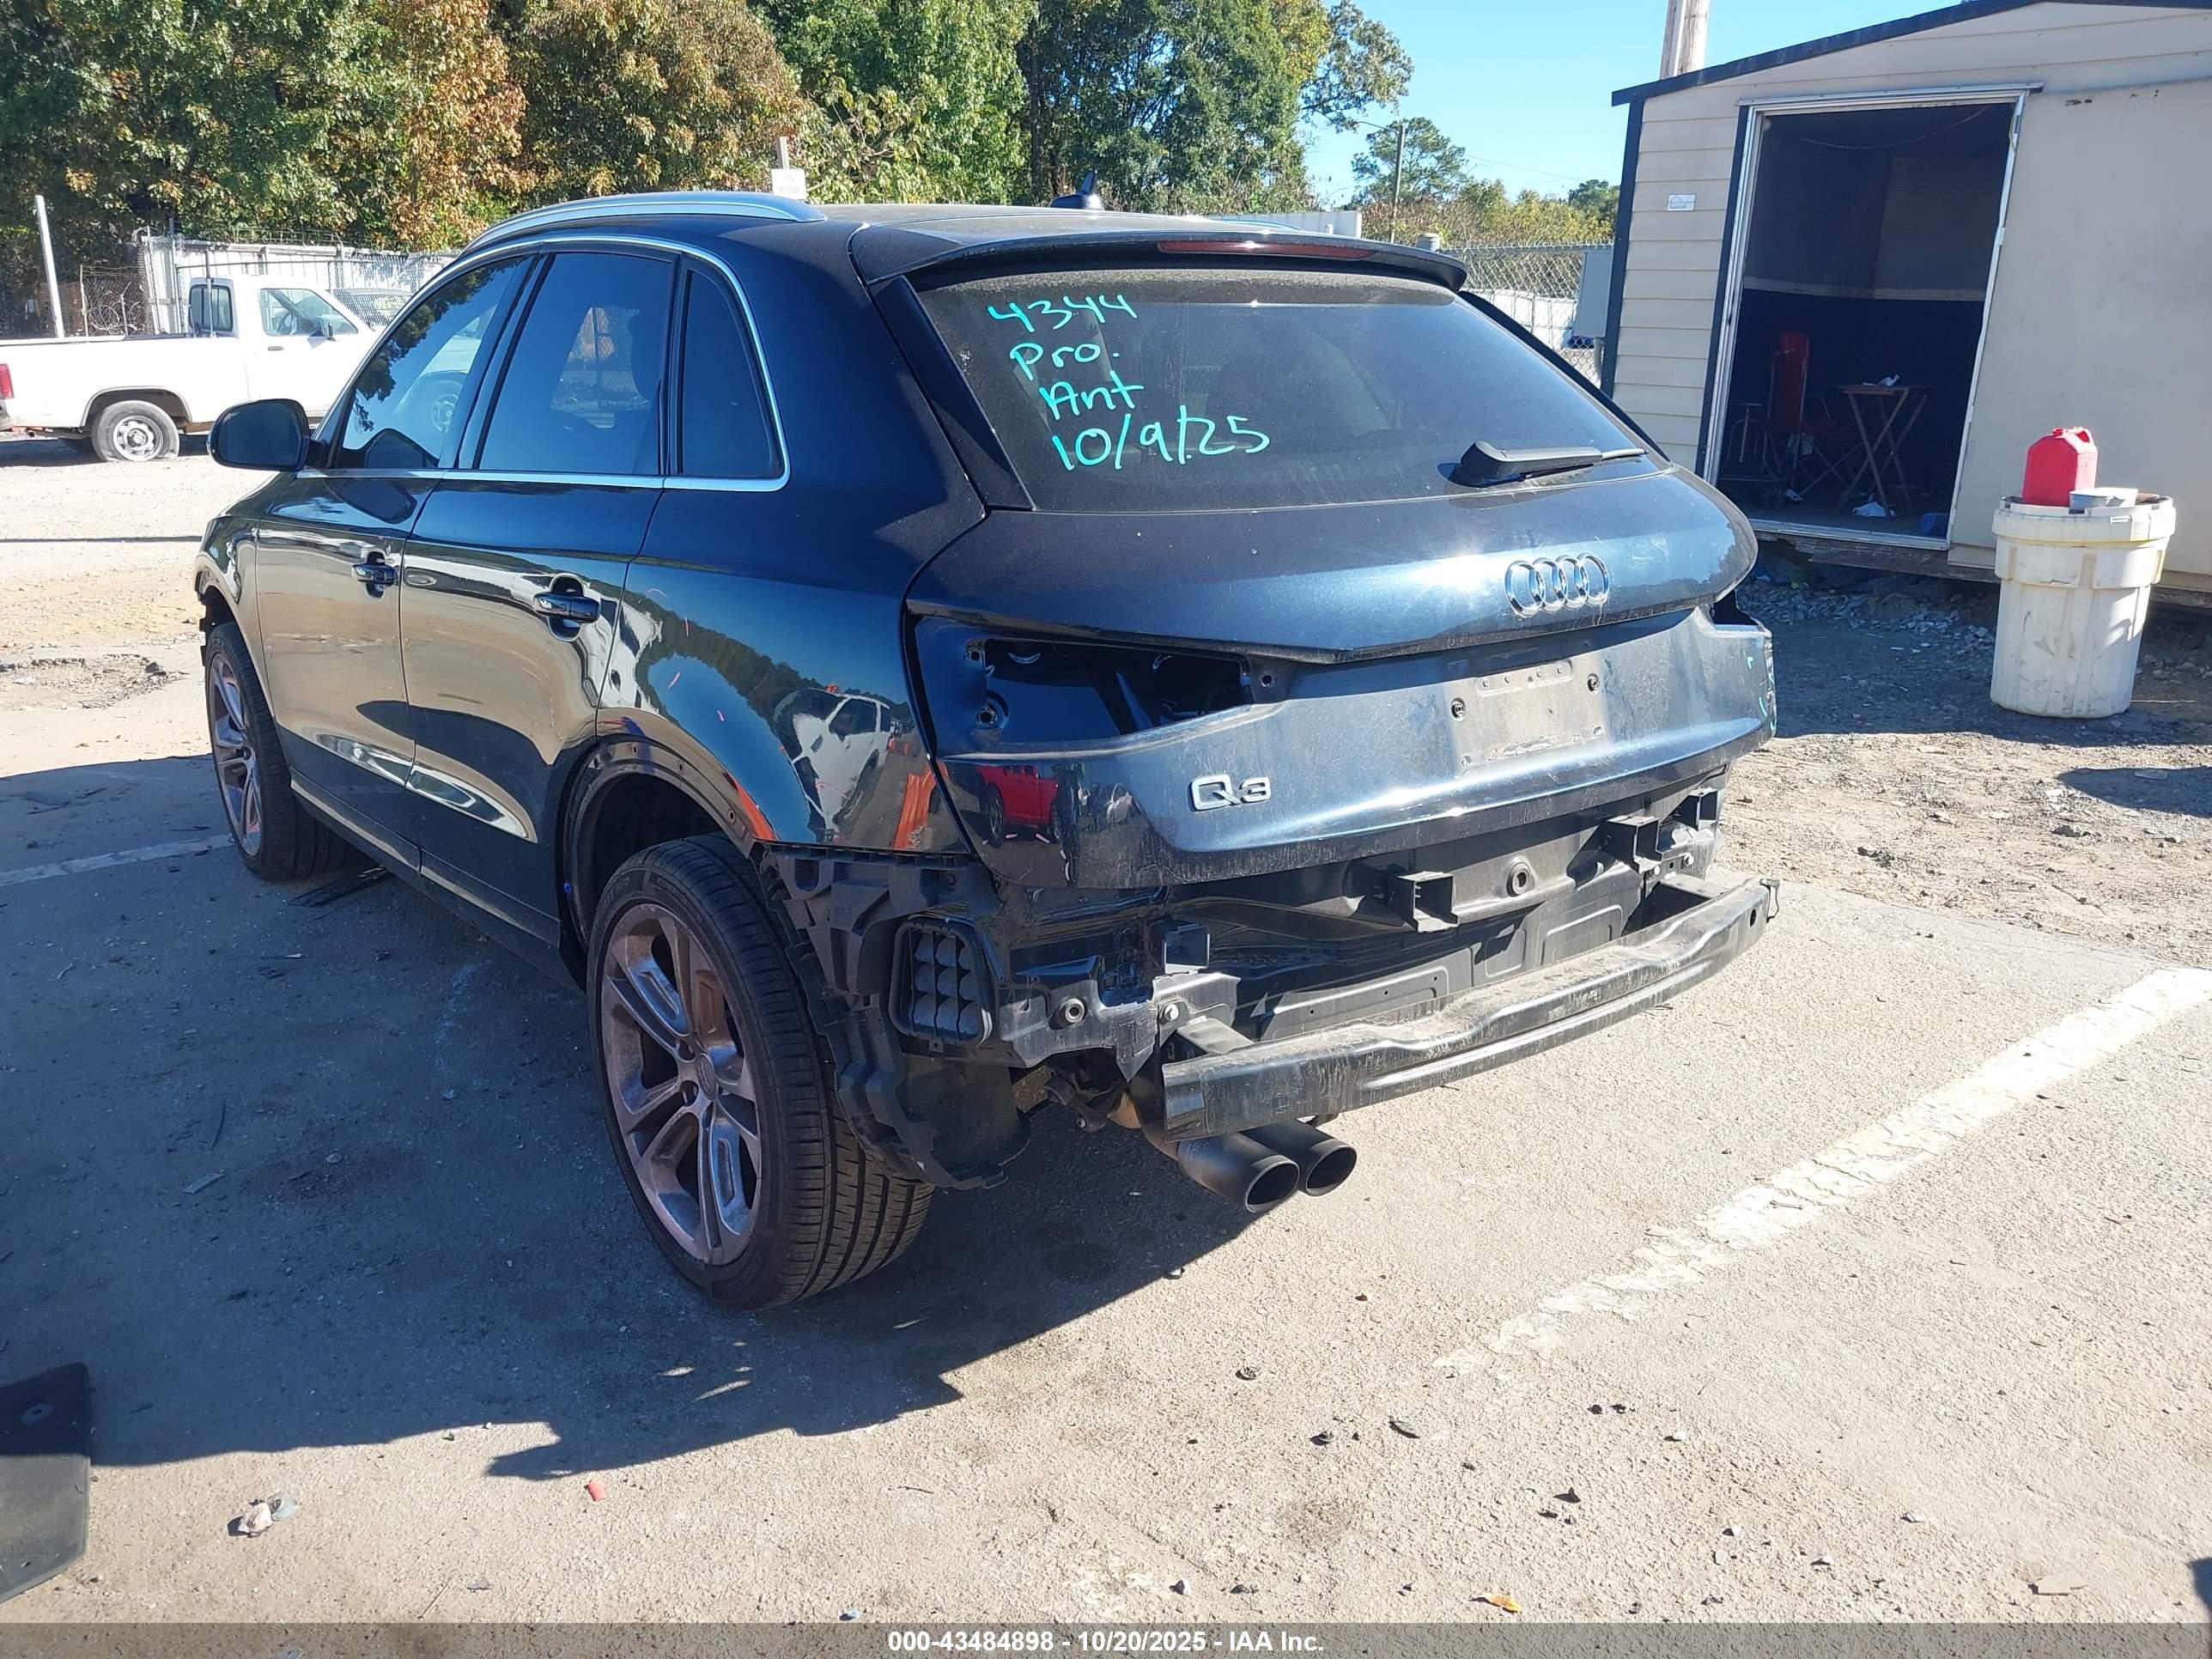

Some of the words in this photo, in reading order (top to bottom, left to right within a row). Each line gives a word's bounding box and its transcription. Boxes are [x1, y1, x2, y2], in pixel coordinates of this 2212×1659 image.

[988, 294, 1138, 333] 4344
[1039, 370, 1145, 421] Ant
[1188, 774, 1272, 811] Q3
